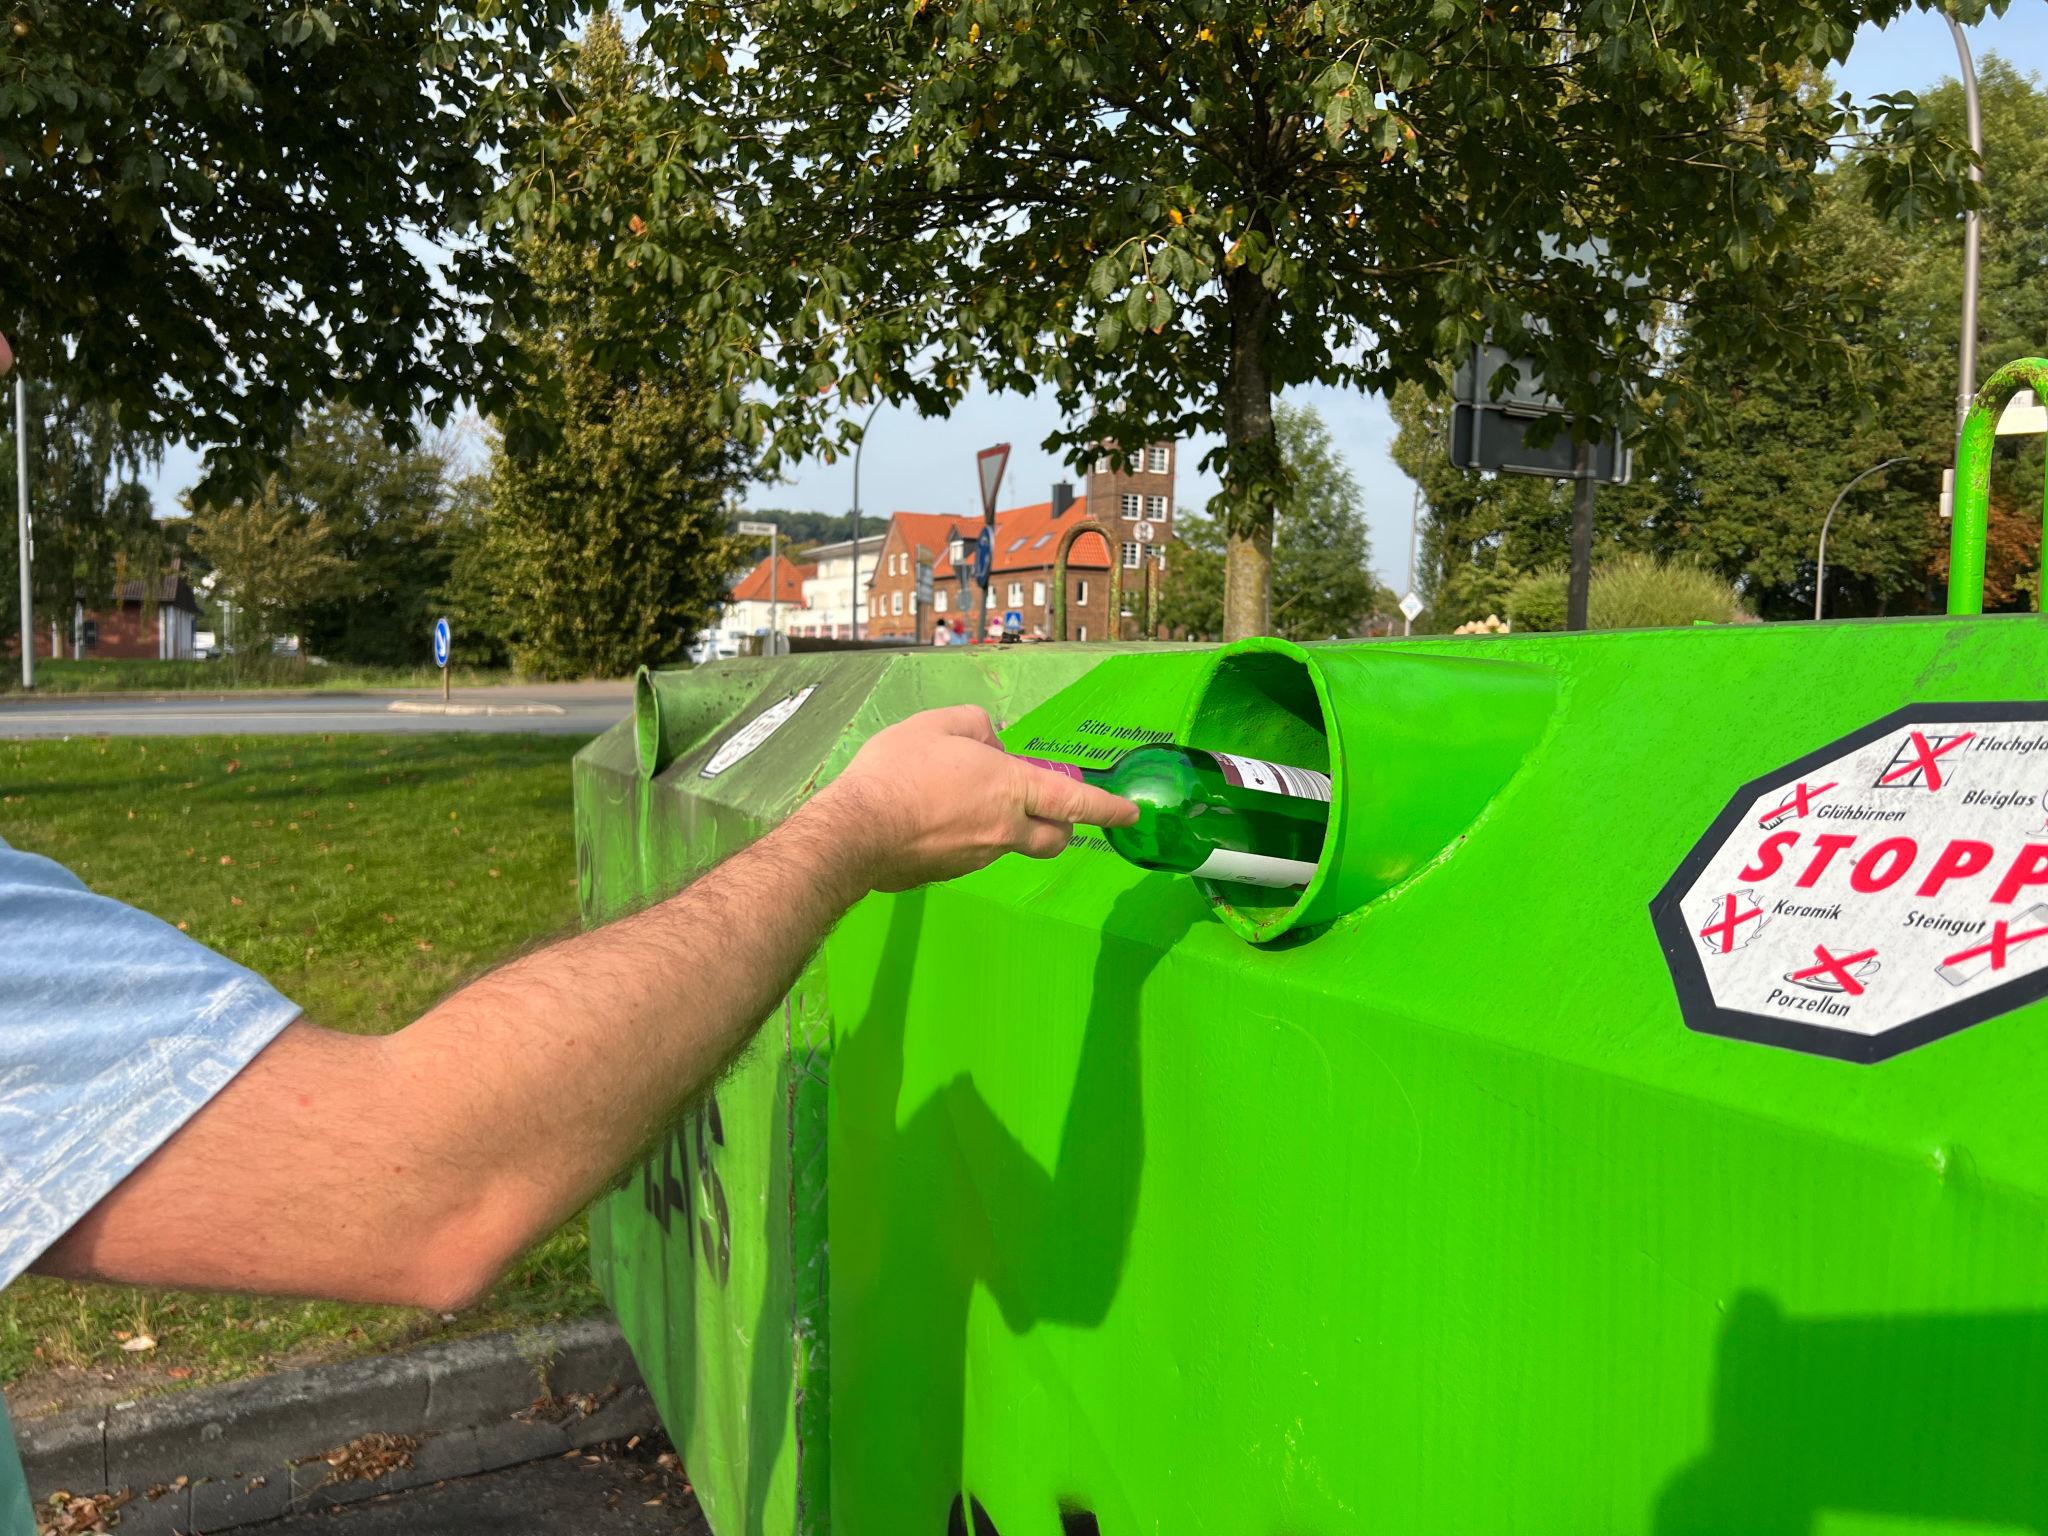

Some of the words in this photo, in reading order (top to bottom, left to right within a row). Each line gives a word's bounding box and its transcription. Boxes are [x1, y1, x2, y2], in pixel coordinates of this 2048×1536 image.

[1077, 719, 1112, 736] Bitte
[1024, 737, 1089, 756] Rücksicht
[1084, 745, 1117, 761] auf
[1961, 789, 2037, 810] Bleiglas
[1816, 804, 1906, 822] Glühbirnen
[1737, 830, 2048, 905] STOPP
[1772, 899, 1842, 921] Keramik
[1903, 910, 1987, 937] Steingut
[1766, 988, 1851, 1017] Porzellan
